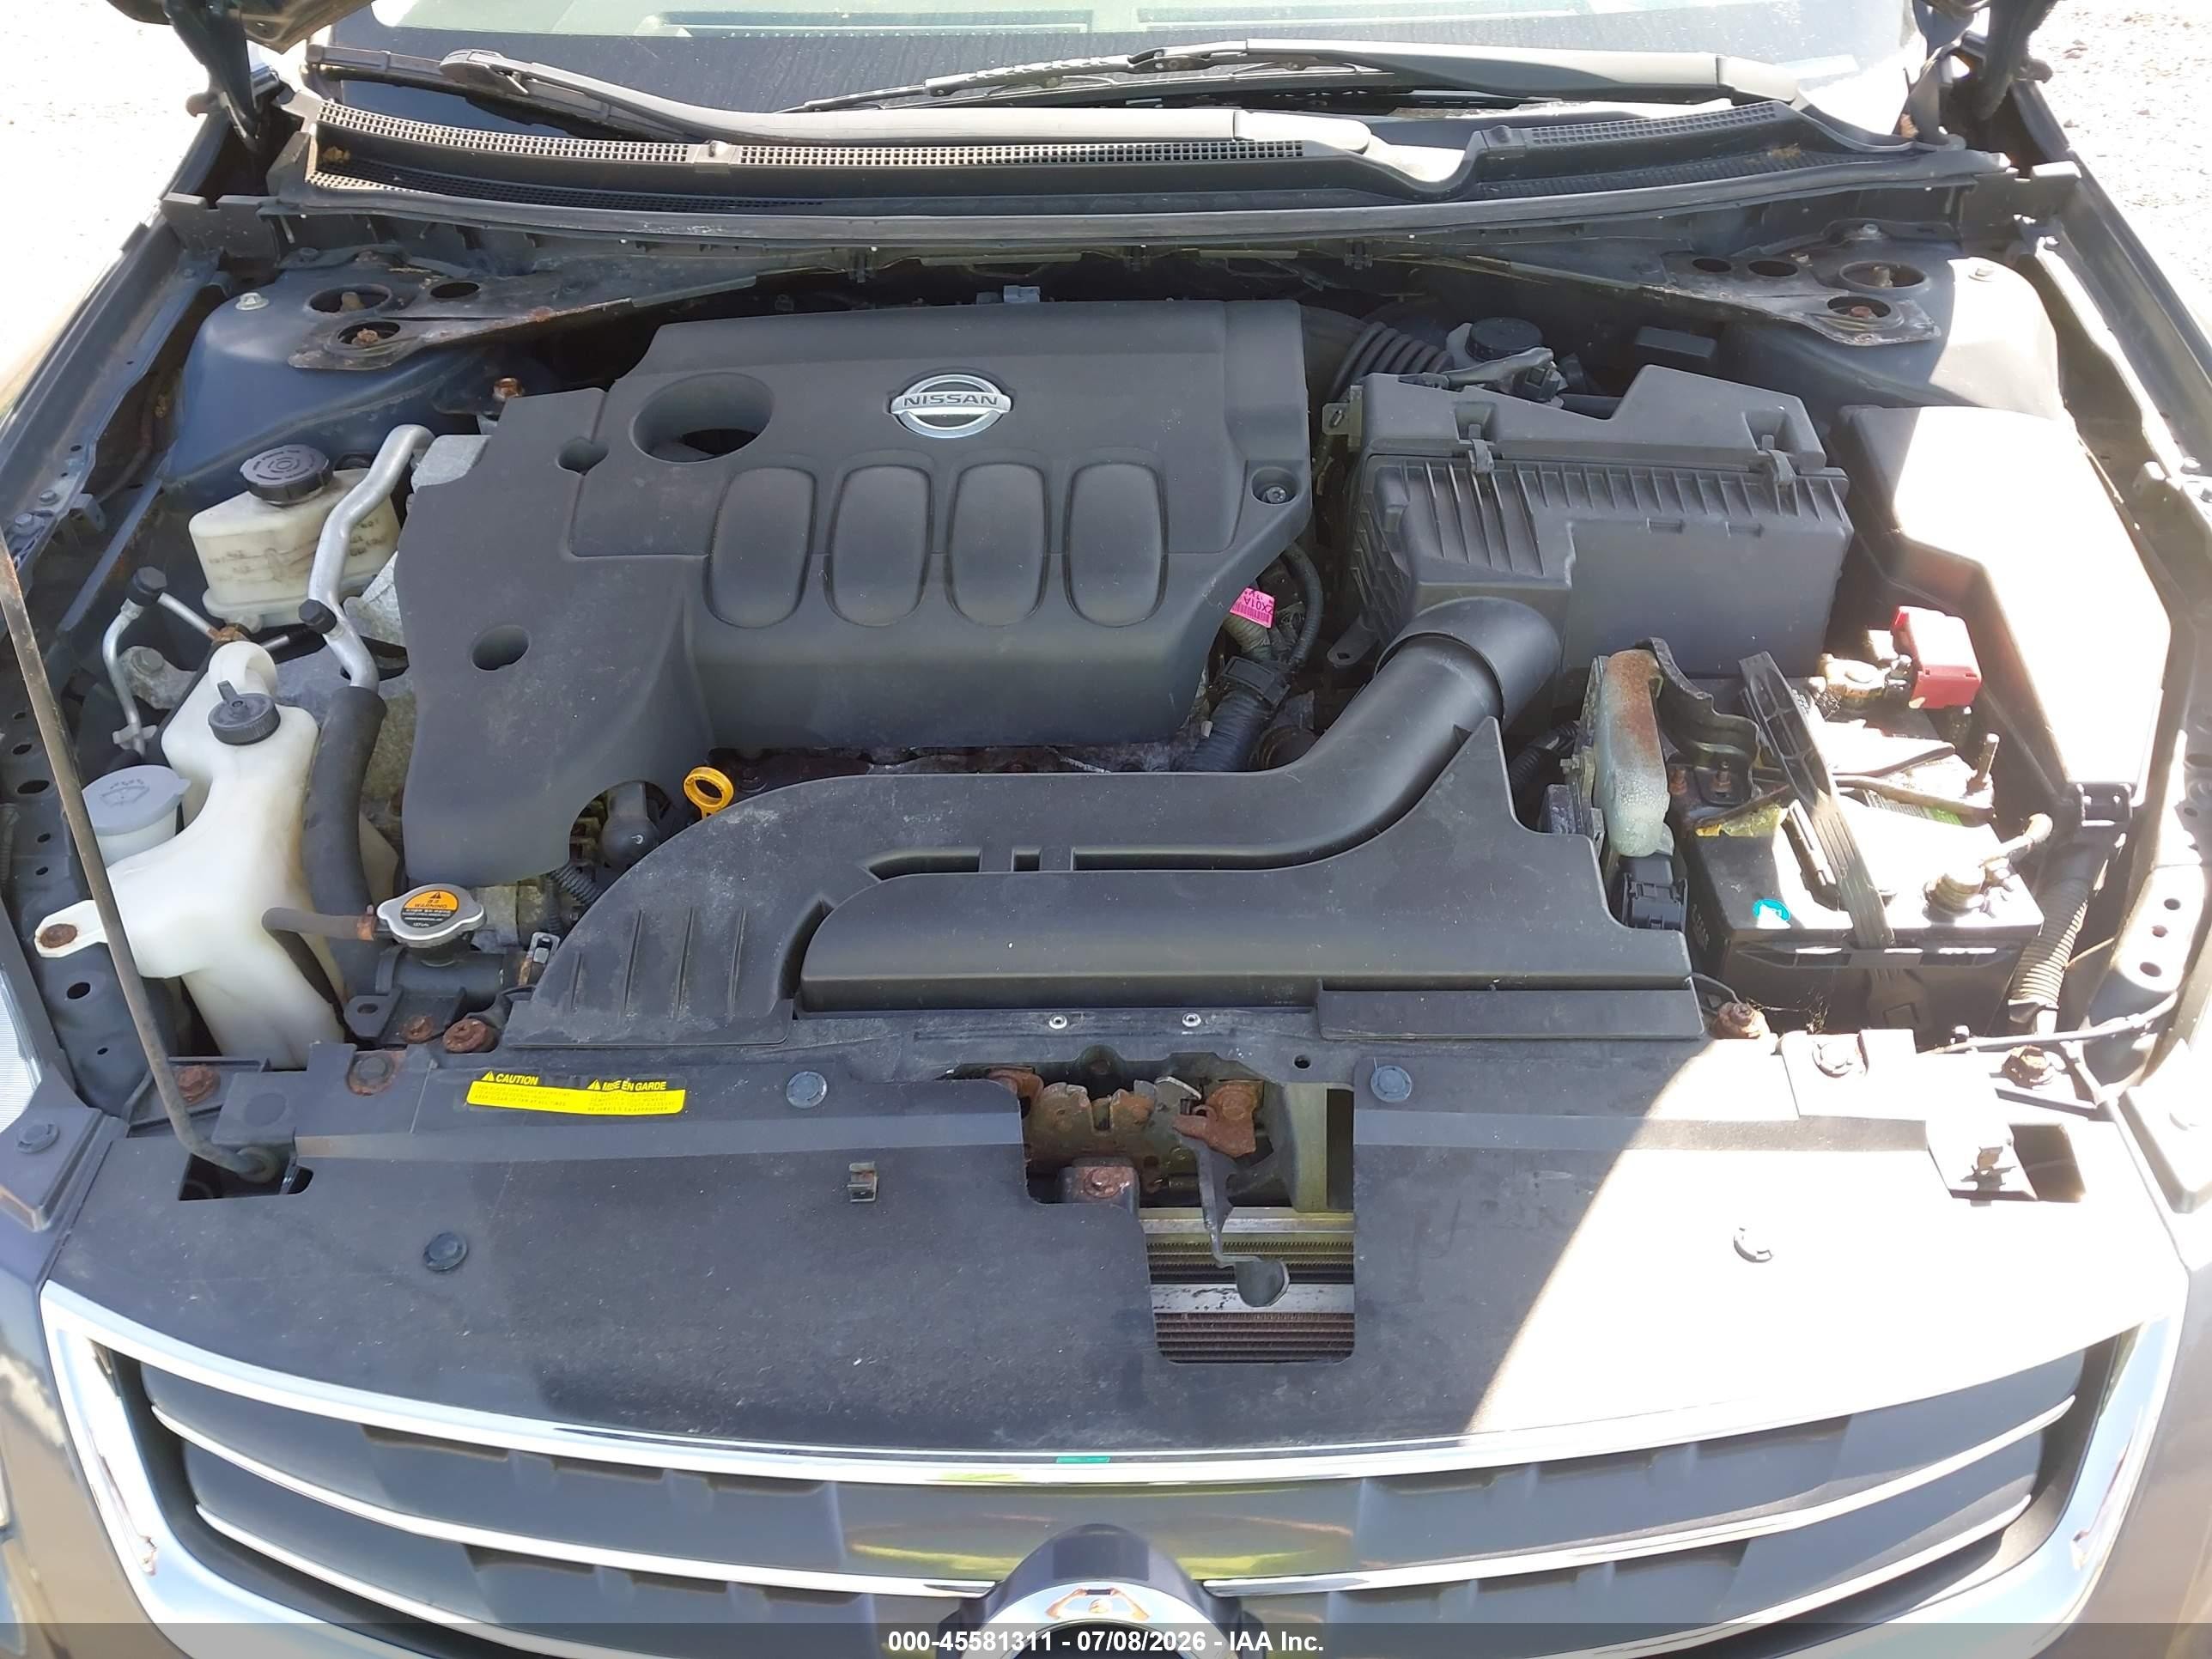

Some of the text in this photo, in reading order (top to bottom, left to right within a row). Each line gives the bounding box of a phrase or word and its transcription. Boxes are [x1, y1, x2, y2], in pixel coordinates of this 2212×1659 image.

[903, 393, 998, 406] NISSAN
[495, 1073, 539, 1085] CAUTION
[602, 1079, 622, 1091] MISE
[635, 1081, 667, 1091] GARDE
